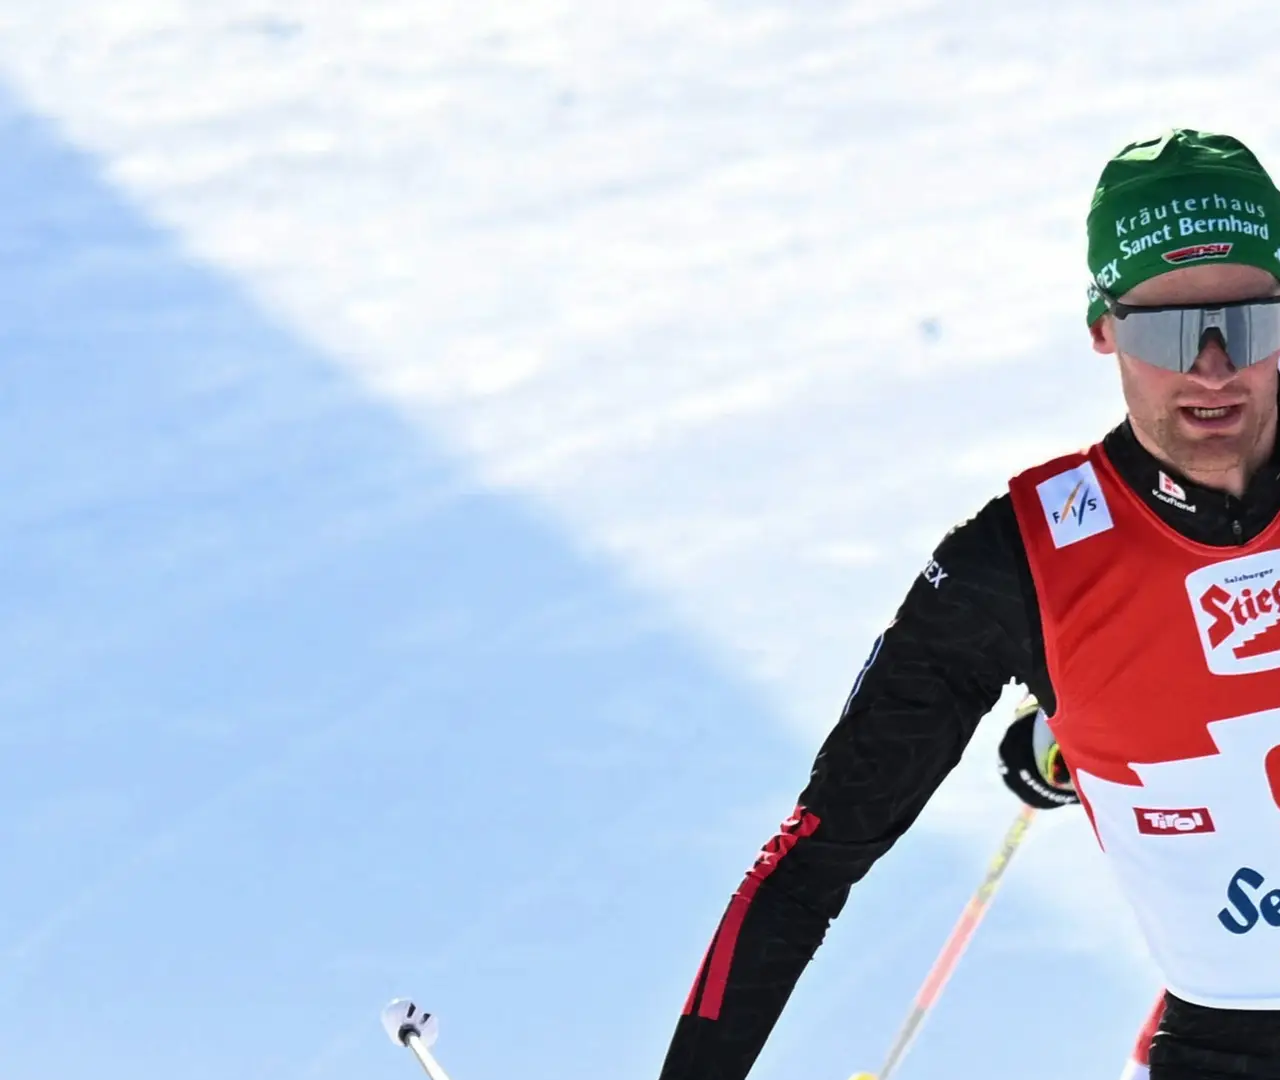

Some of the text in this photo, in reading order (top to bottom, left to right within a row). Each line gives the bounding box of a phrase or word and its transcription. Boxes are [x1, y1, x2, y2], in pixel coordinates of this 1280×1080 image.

[1115, 193, 1266, 237] Kräuterhaus
[1120, 215, 1270, 260] Sanct Bernhard
[1152, 488, 1197, 514] Kaufland
[1223, 567, 1274, 585] Salzburger
[1143, 811, 1204, 832] Tirol
